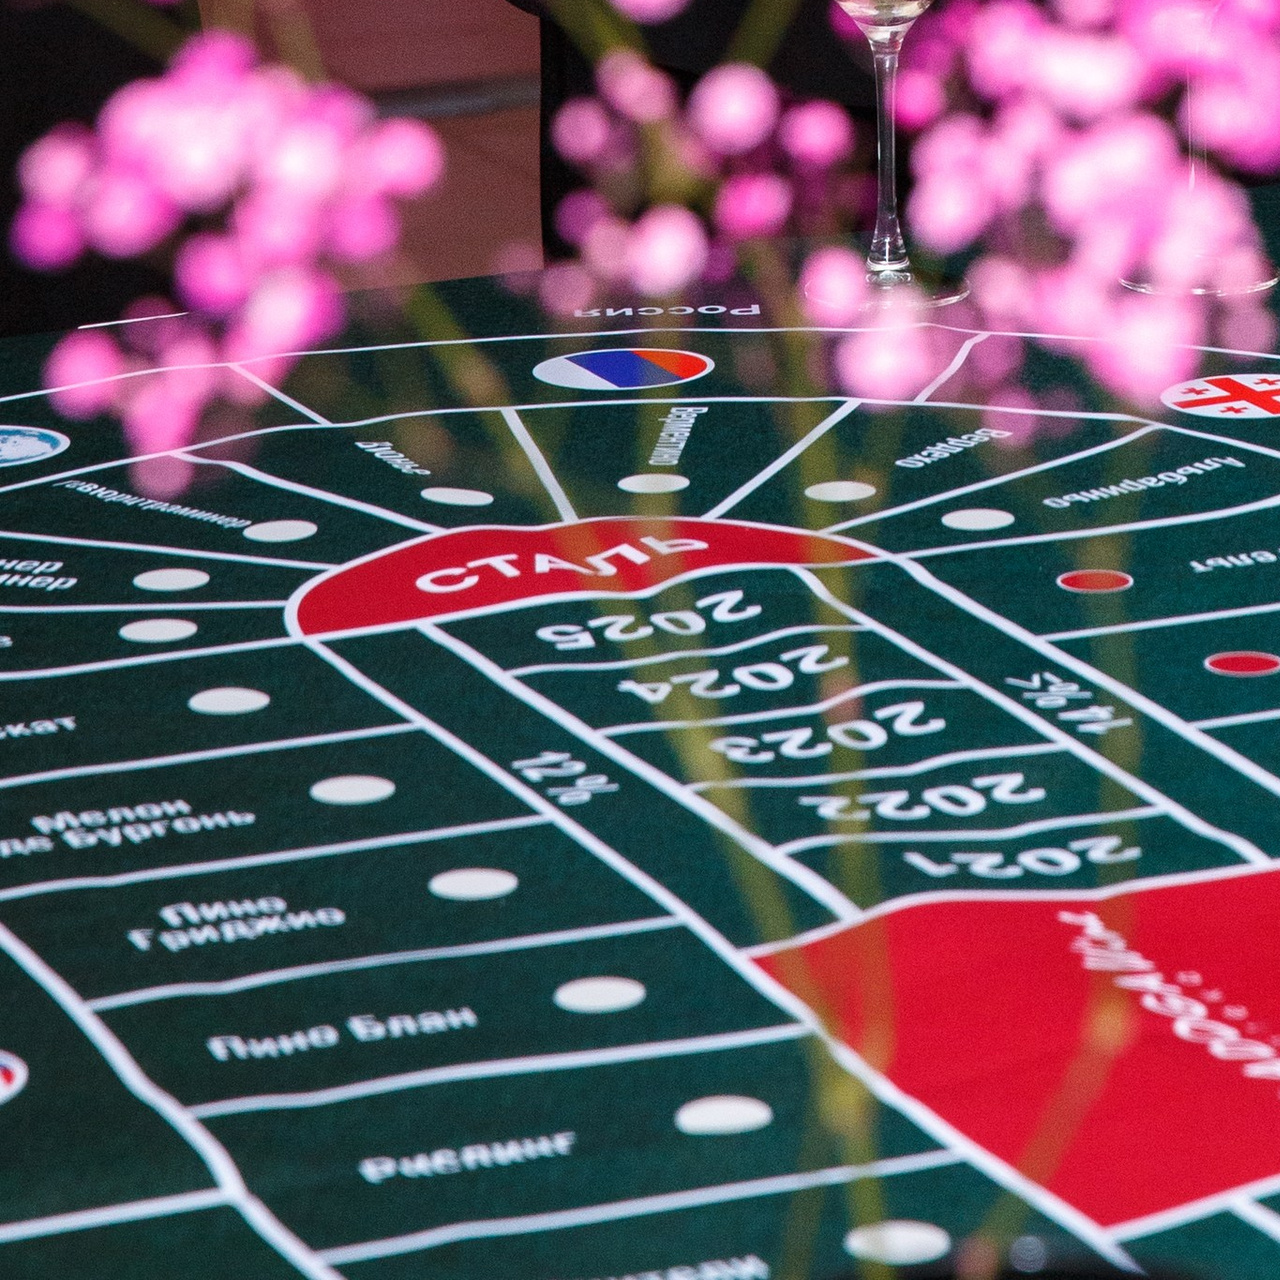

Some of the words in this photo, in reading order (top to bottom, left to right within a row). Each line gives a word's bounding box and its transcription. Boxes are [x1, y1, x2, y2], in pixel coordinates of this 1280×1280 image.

[574, 304, 761, 318] Россия
[354, 441, 431, 475] Вионье
[648, 406, 709, 466] Верментино
[895, 427, 1013, 468] Вердехо
[1042, 454, 1246, 511] Альбариньо
[415, 534, 709, 594] СТАЛЬ
[536, 589, 762, 650] 2025
[616, 643, 850, 702] 2024
[710, 700, 946, 763] 2023
[511, 750, 621, 806] 12%
[799, 771, 1046, 821] 2022
[32, 799, 191, 835] Мелон
[62, 810, 255, 850] Бургонь
[903, 835, 1142, 878] 2021
[127, 906, 347, 953] Гриджио
[158, 896, 287, 928] Пино
[207, 1024, 339, 1060] Пино
[347, 1006, 477, 1042] Блан
[359, 1130, 575, 1184] Рислинг
